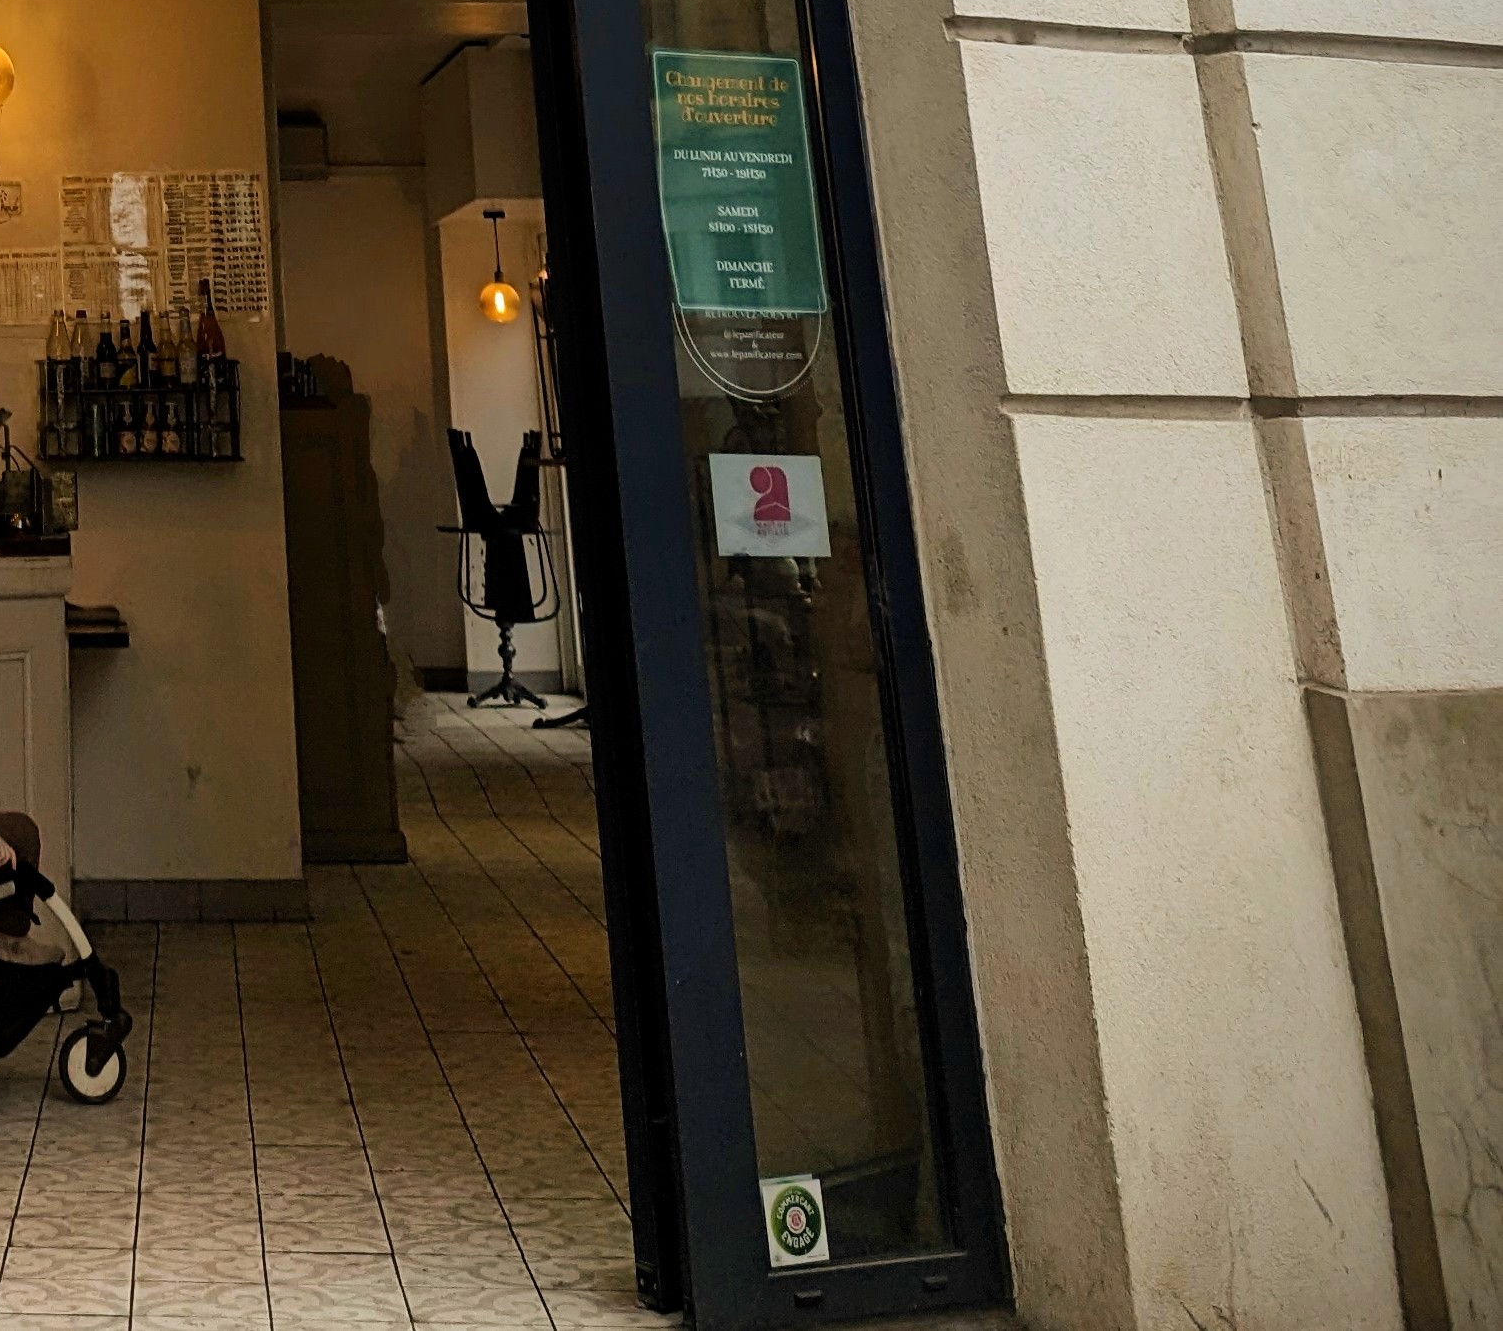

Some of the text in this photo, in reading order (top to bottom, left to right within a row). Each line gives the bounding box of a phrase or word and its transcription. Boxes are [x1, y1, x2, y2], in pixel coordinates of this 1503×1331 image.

[770, 77, 788, 92] de
[677, 90, 780, 108] nos horaires
[674, 149, 793, 165] DU LUNDI AU VENDREDI
[701, 167, 728, 179] 7H30
[718, 205, 759, 217] SAMEDI
[715, 259, 774, 273] DIMANCHE
